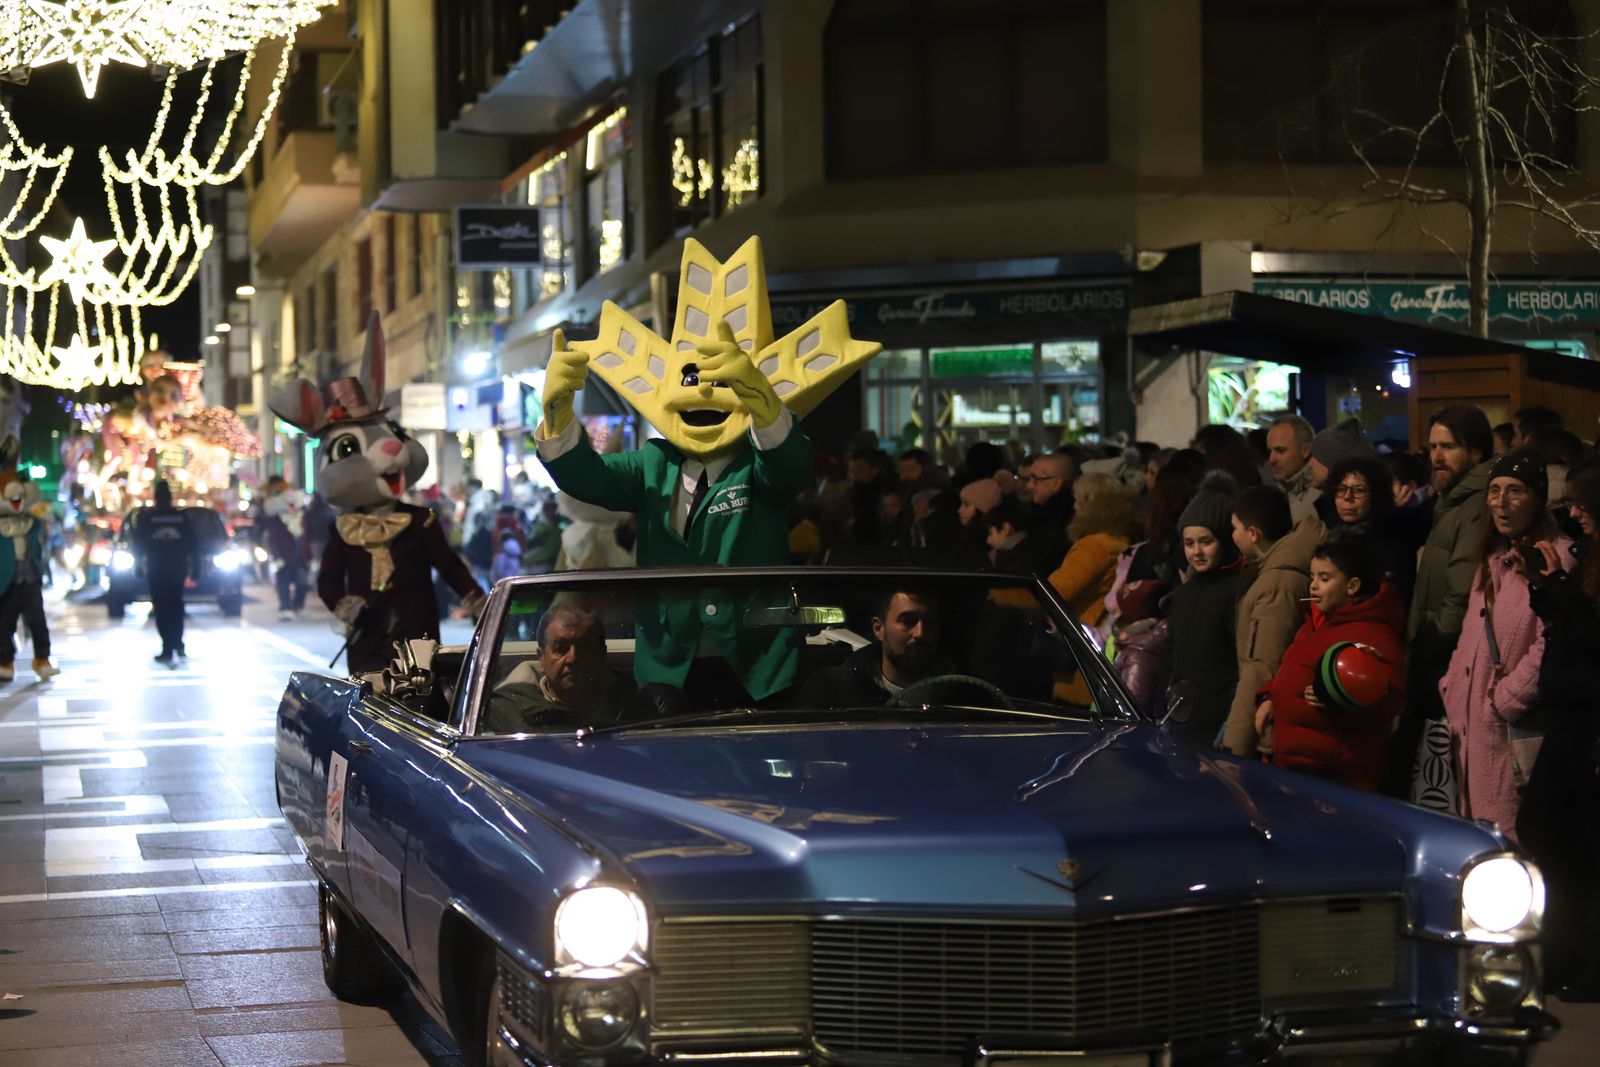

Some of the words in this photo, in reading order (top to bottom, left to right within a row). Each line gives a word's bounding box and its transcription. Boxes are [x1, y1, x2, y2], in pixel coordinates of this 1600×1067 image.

[1000, 290, 1125, 314] HERBOLARIOS
[1256, 288, 1371, 310] RBOLARIOS
[1506, 290, 1600, 310] HERBOLARI
[708, 502, 730, 513] CAJA
